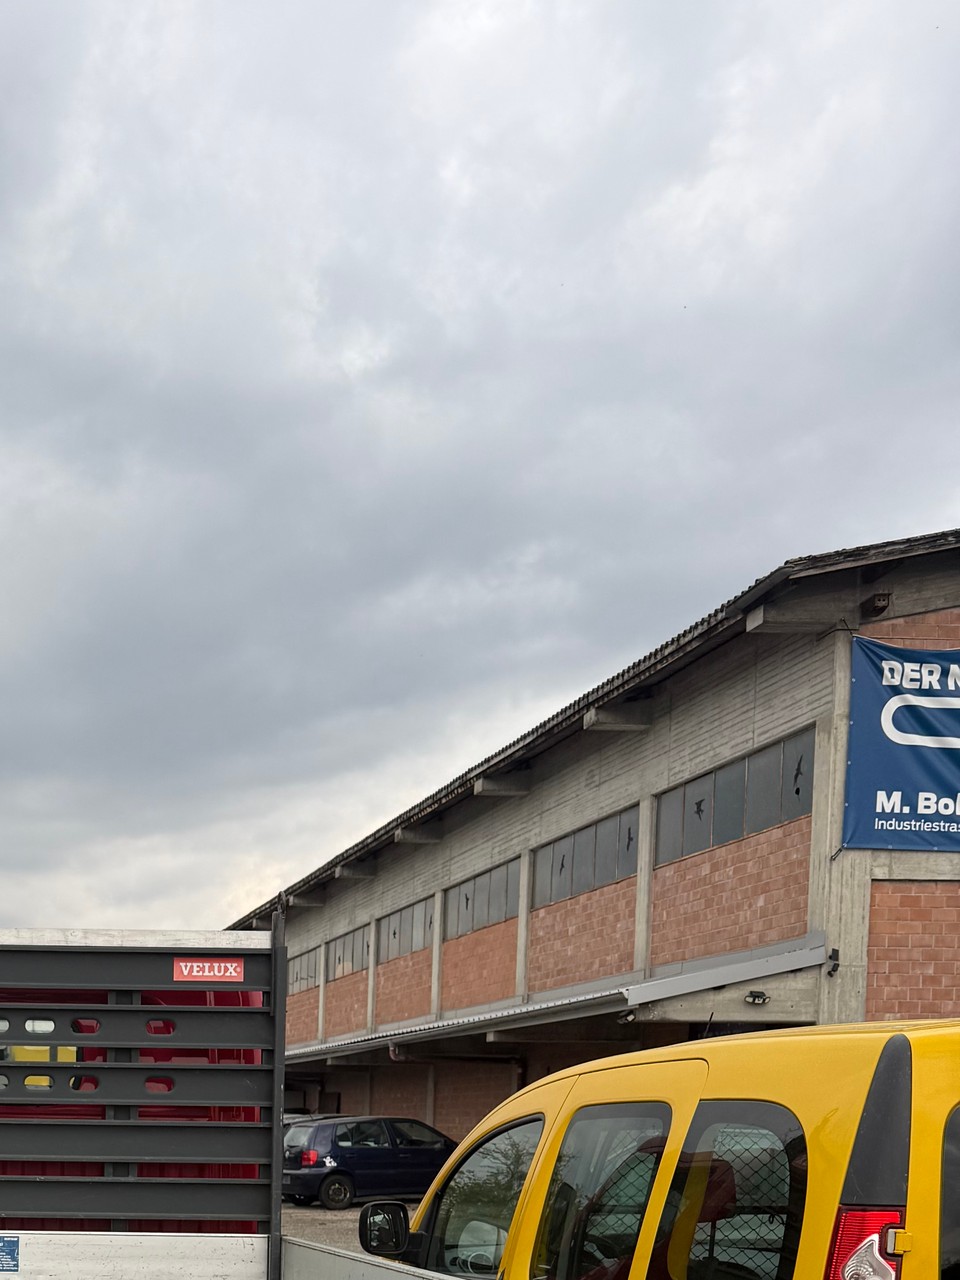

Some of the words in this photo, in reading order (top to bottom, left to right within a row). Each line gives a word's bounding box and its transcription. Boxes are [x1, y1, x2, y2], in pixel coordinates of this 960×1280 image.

[881, 660, 942, 690] DER
[875, 791, 910, 815] M.
[179, 962, 238, 977] VELUX
